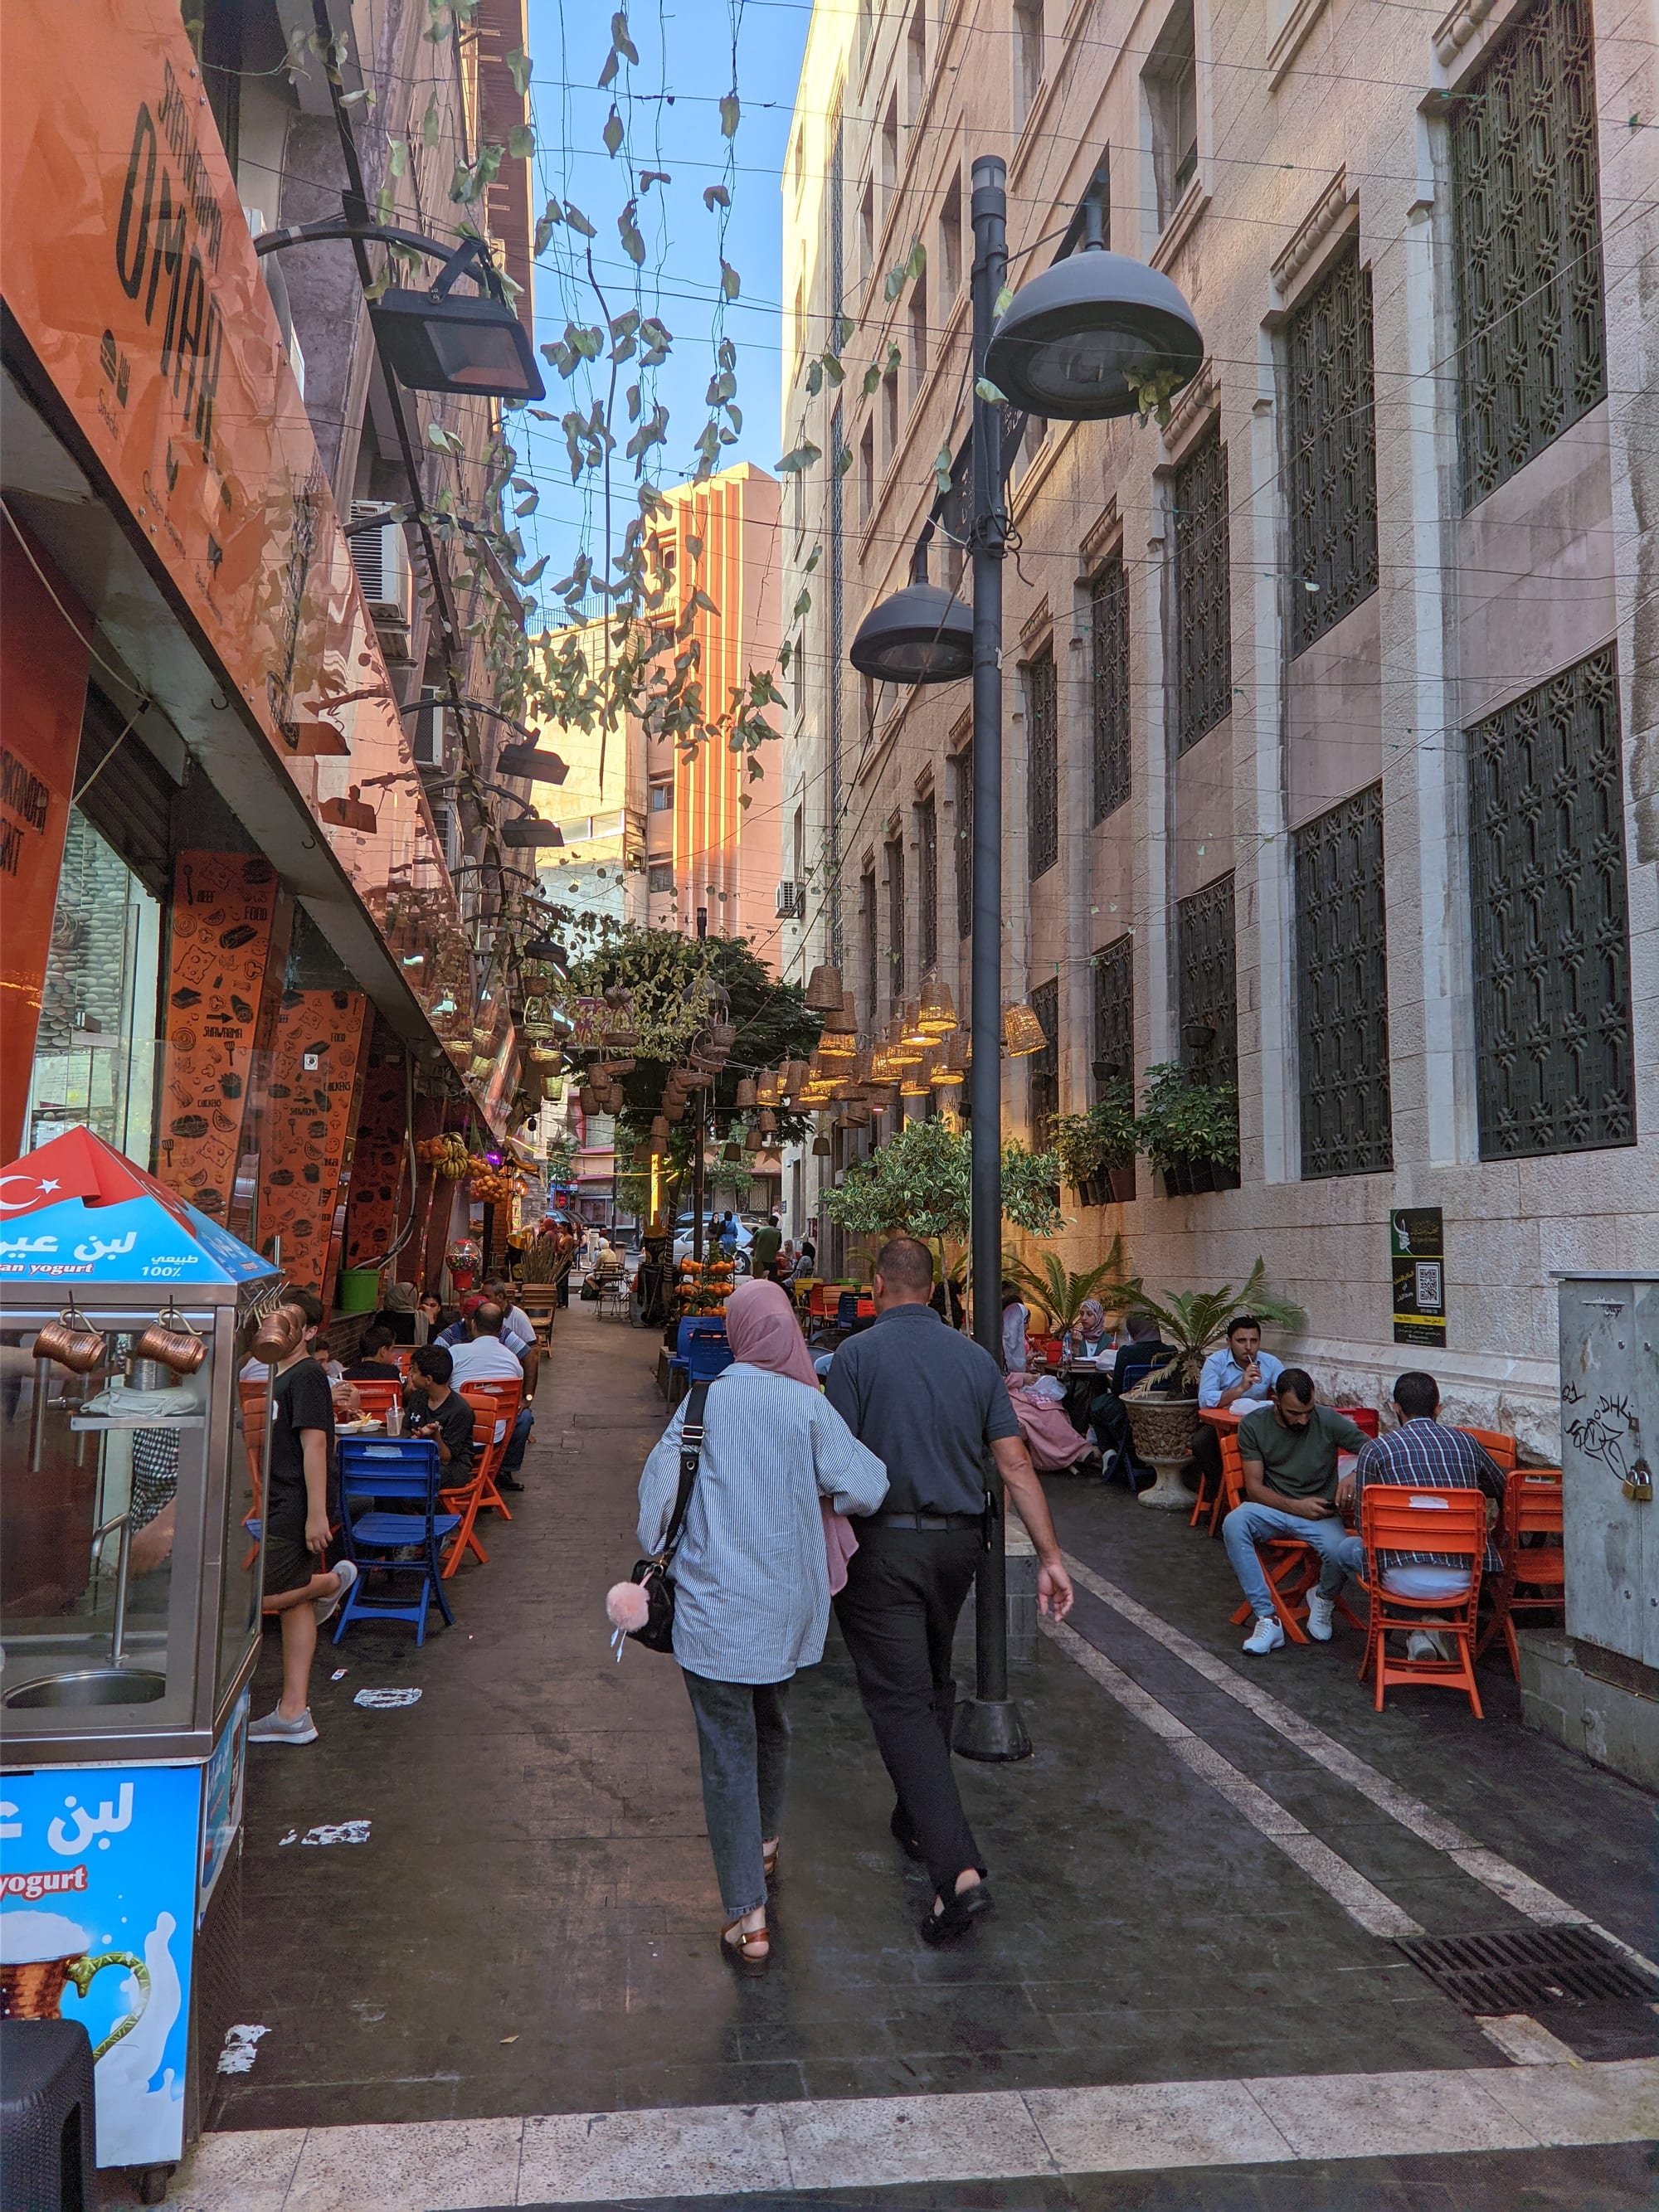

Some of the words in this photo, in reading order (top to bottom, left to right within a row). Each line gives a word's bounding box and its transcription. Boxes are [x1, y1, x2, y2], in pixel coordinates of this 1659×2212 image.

[158, 58, 222, 274] SHAWARMA
[116, 101, 223, 459] OMAR
[197, 890, 215, 902] BEEF
[245, 906, 266, 921] FOOD
[203, 1026, 242, 1038] SHAWARMA
[331, 1033, 345, 1042] FOOD
[324, 1082, 350, 1091] CHICKENS
[197, 1099, 221, 1107] CHICKENS
[73, 1232, 138, 1262] لبن
[151, 1255, 199, 1265] طبيعي
[30, 1263, 94, 1276] yogurt
[141, 1266, 181, 1277] 100%
[47, 1782, 134, 1855] لبن
